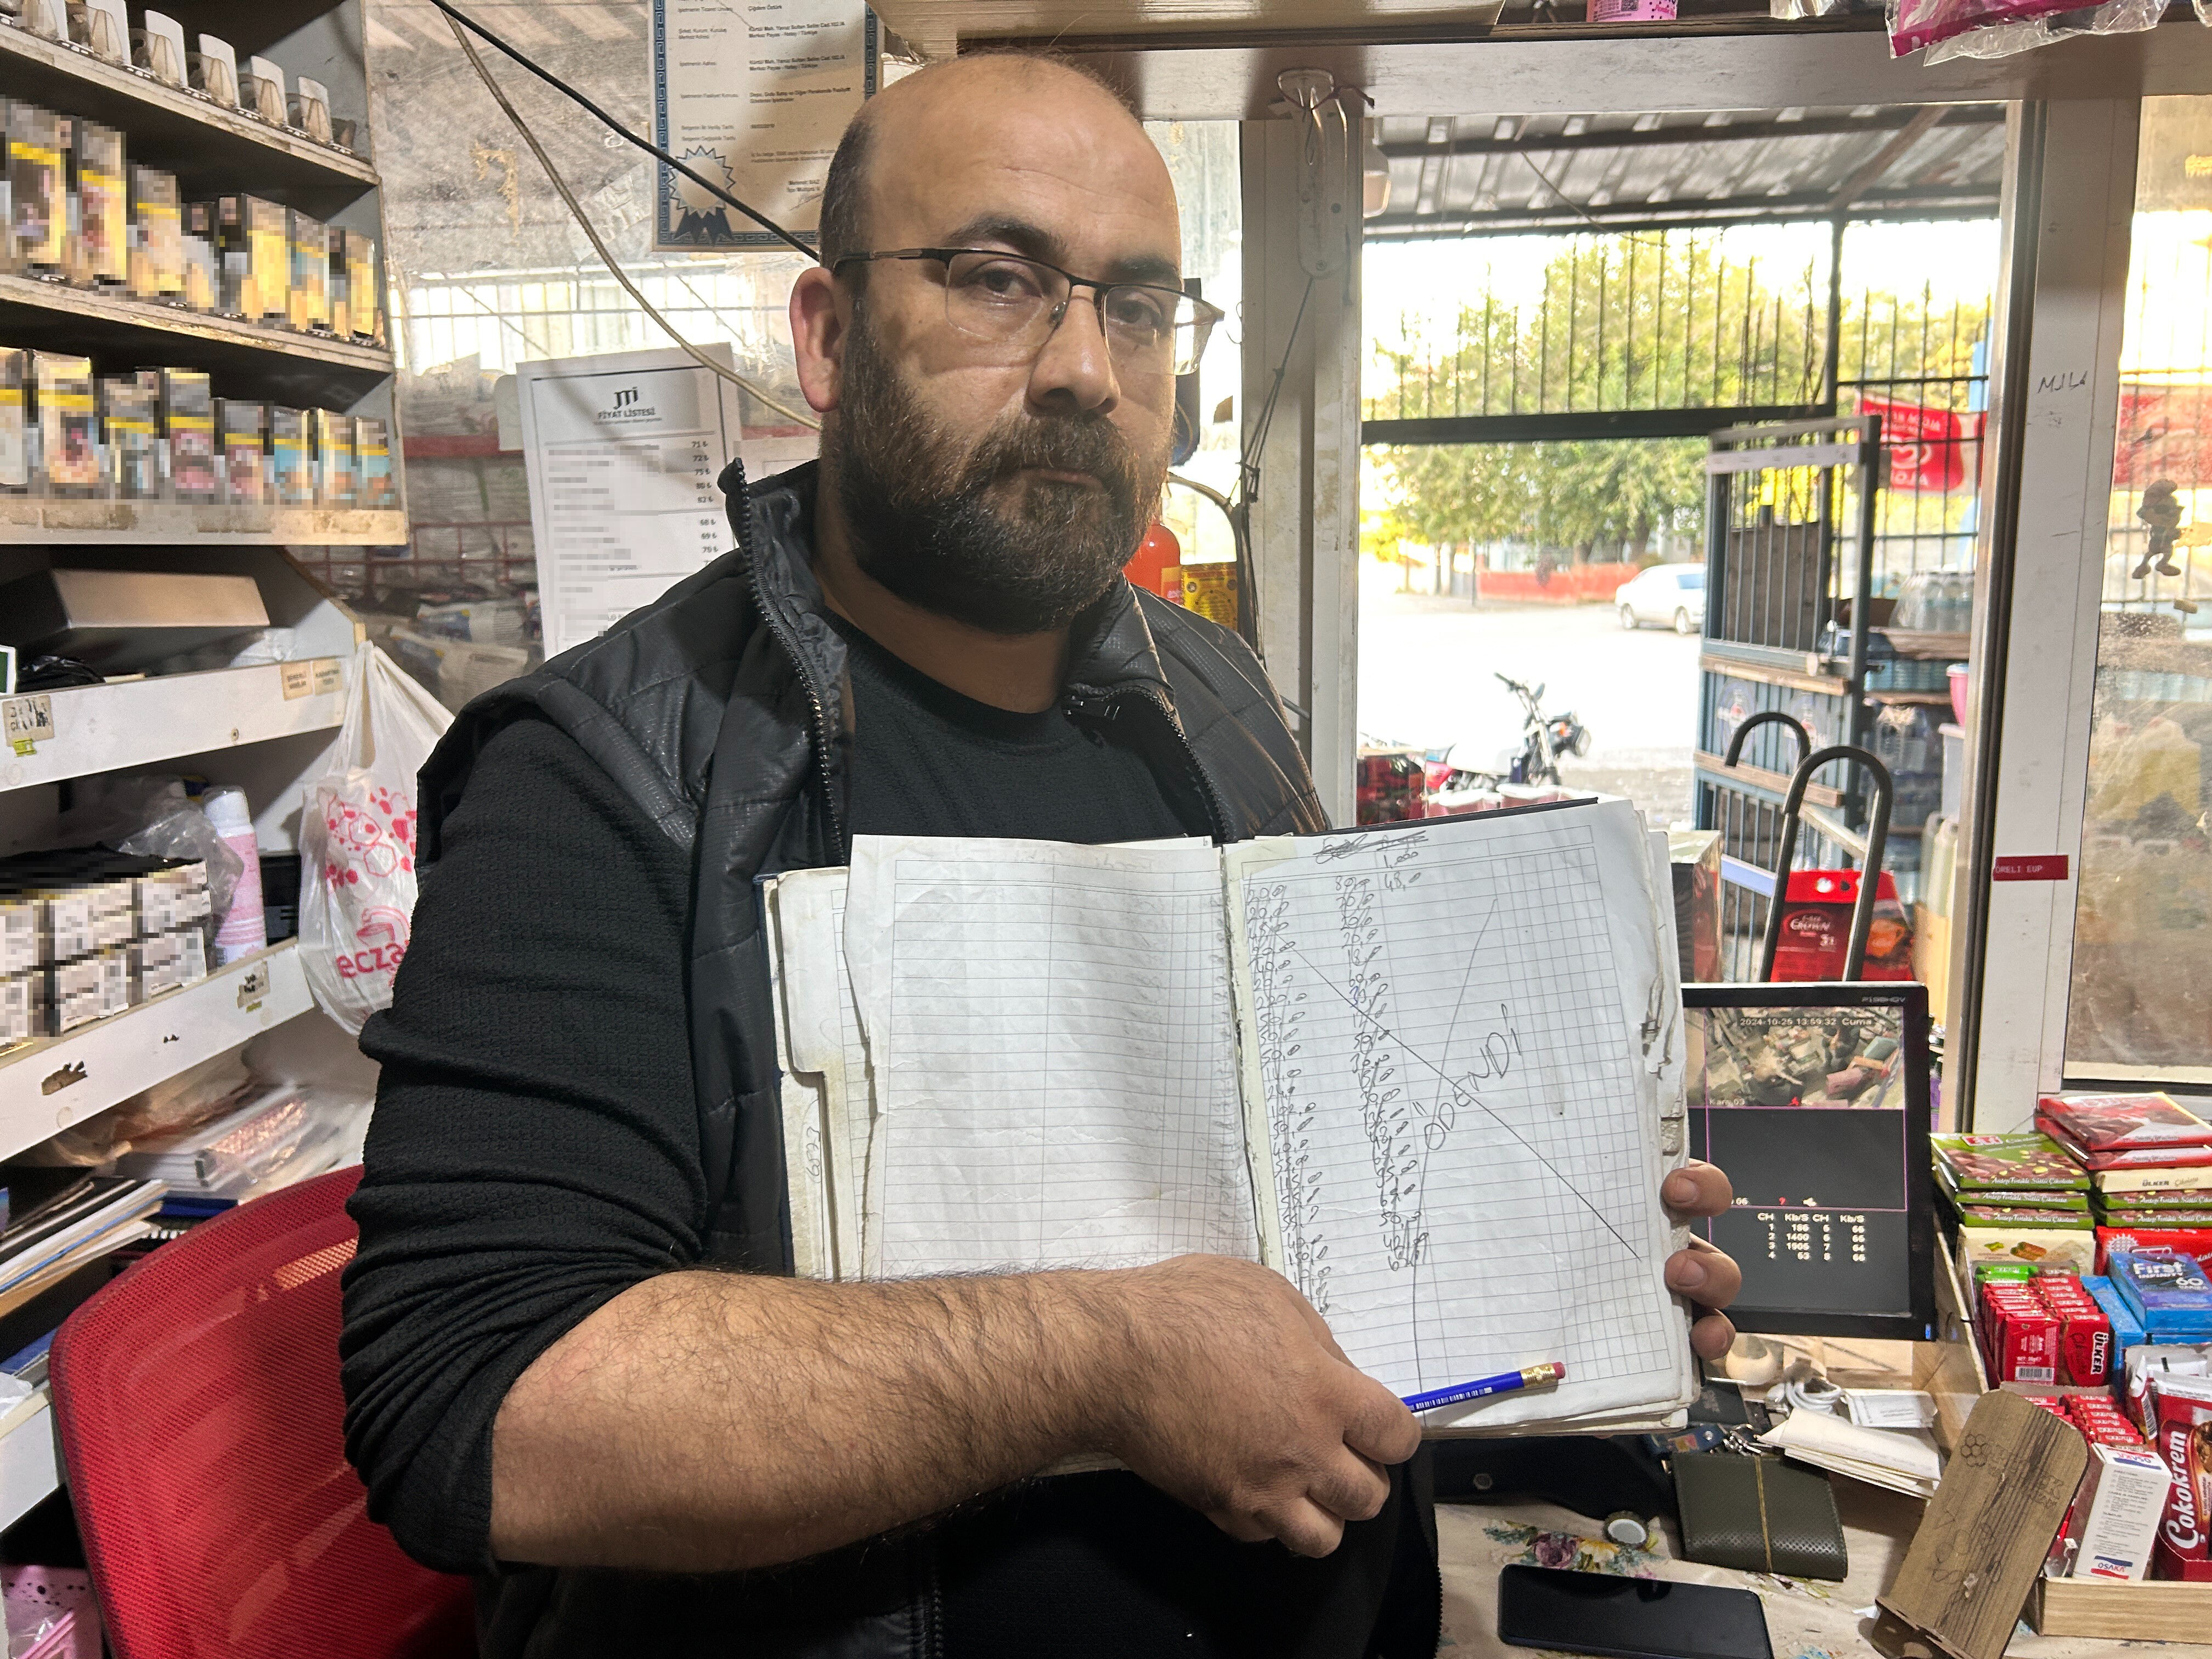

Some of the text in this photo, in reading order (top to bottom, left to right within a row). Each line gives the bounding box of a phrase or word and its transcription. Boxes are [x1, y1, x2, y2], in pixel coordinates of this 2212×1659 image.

[1757, 1212, 1775, 1221] CH
[1812, 1214, 1830, 1222] CH
[1768, 1232, 1776, 1240] 2
[2132, 1262, 2185, 1275] First
[2176, 1277, 2204, 1286] 60
[2092, 1333, 2108, 1373] ÜLKER
[2098, 1562, 2125, 1572] OSAKA
